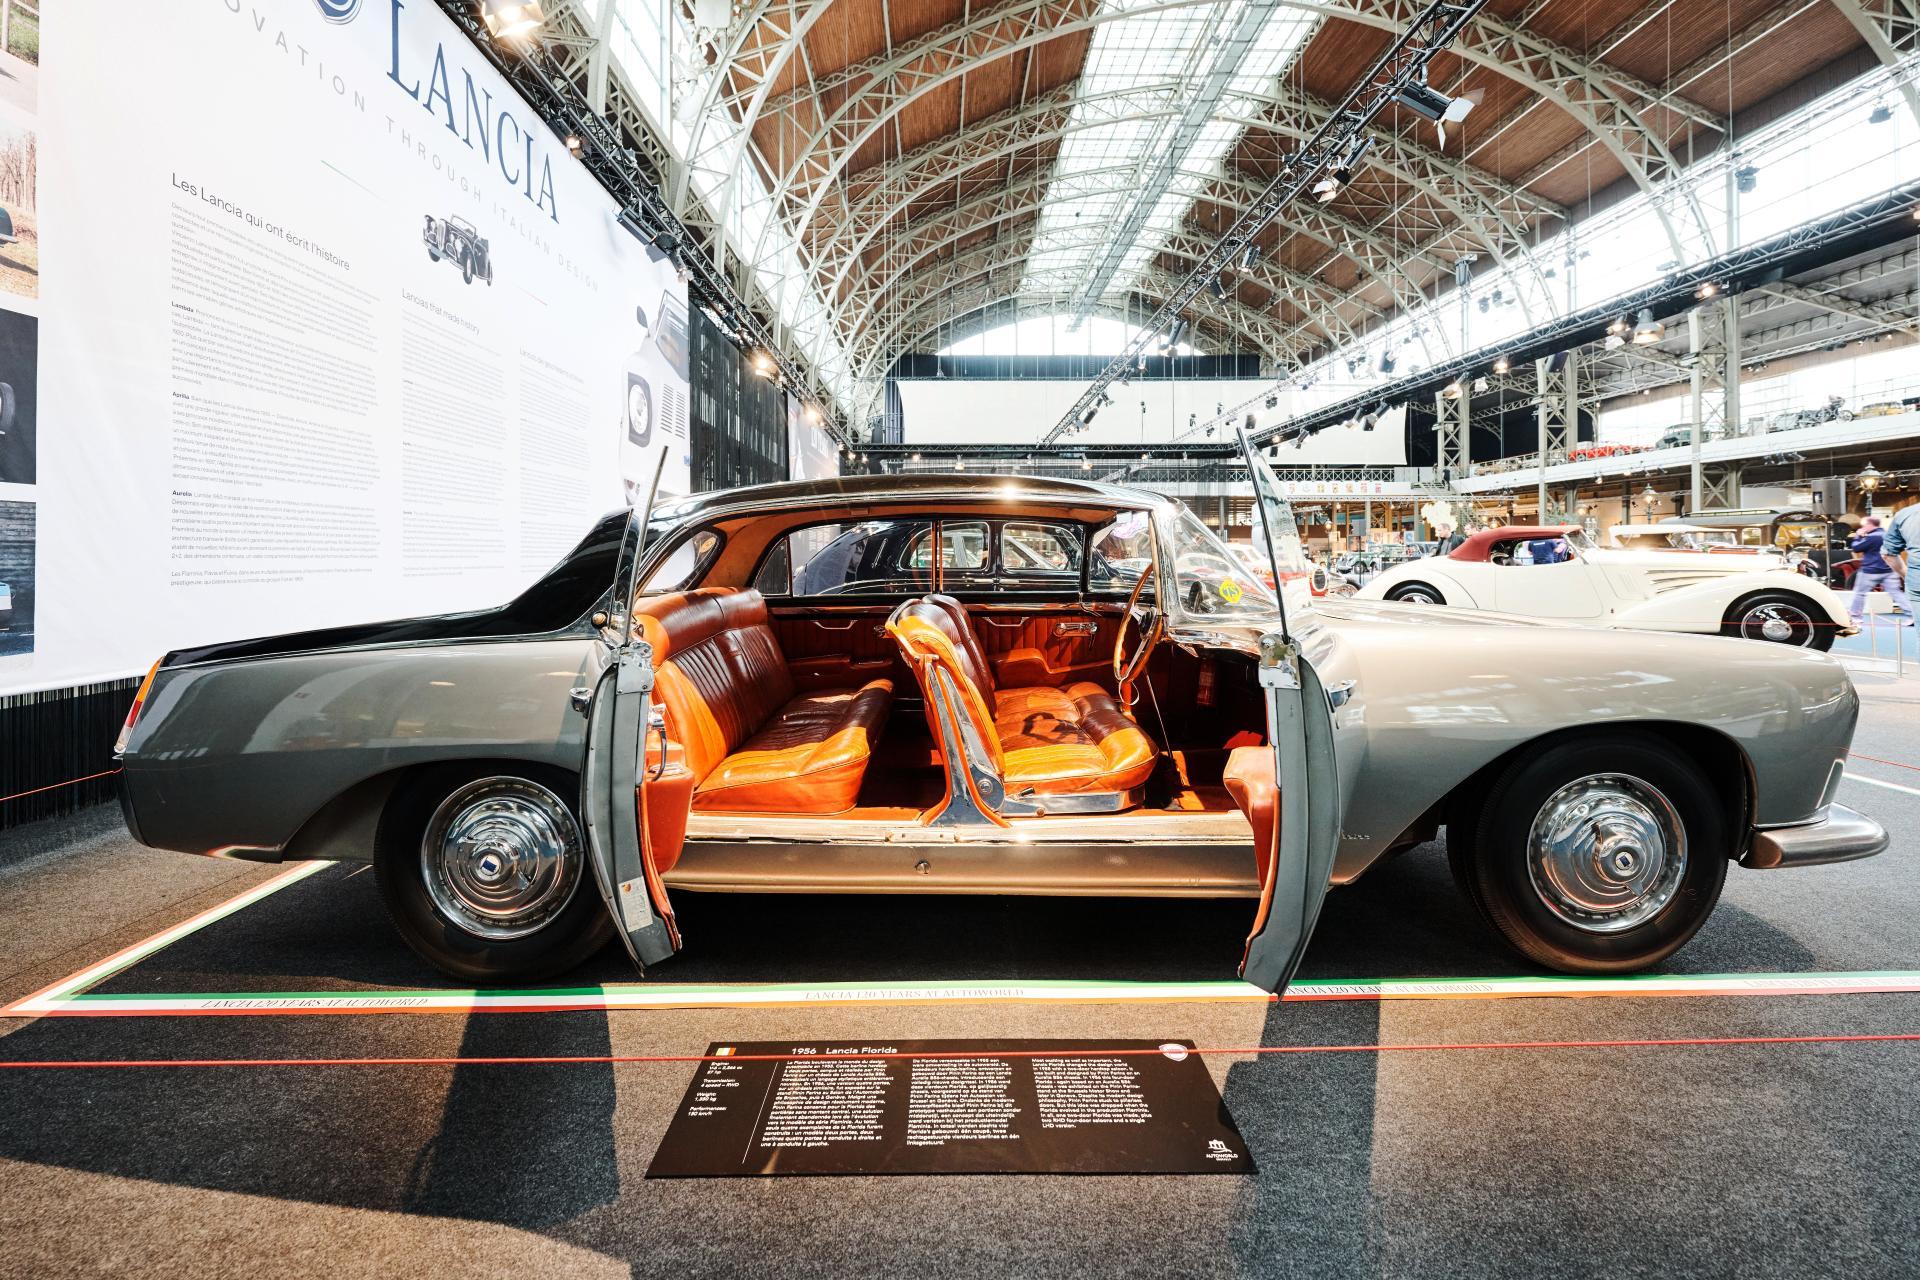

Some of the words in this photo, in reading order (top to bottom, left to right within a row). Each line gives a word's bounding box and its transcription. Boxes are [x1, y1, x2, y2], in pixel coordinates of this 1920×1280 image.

[387, 0, 559, 224] LANCIA
[385, 115, 481, 203] THROUGH
[493, 202, 550, 256] ITALIAN
[558, 256, 599, 293] DESIGN
[172, 172, 197, 196] Les
[201, 187, 242, 218] Lancia
[246, 213, 263, 228] qui
[266, 222, 283, 238] ont
[286, 231, 309, 251] écrit
[172, 300, 194, 313] Lambda
[806, 991, 854, 1000] LANCIA
[857, 991, 876, 999] 120
[880, 990, 921, 999] YEARS
[927, 989, 940, 998] AT
[943, 988, 1025, 998] AUTOWORLD
[1286, 986, 1327, 995] ANCIA
[1328, 986, 1349, 994] 120
[1350, 985, 1393, 993] YEARS
[1396, 985, 1410, 993] AT
[1414, 984, 1493, 993] AUTOWORLD
[201, 1000, 254, 1008] LANCIA
[254, 1000, 279, 1008] 120
[280, 999, 322, 1007] YEARS
[327, 999, 344, 1007] AT
[346, 998, 429, 1007] AUTOWORLD
